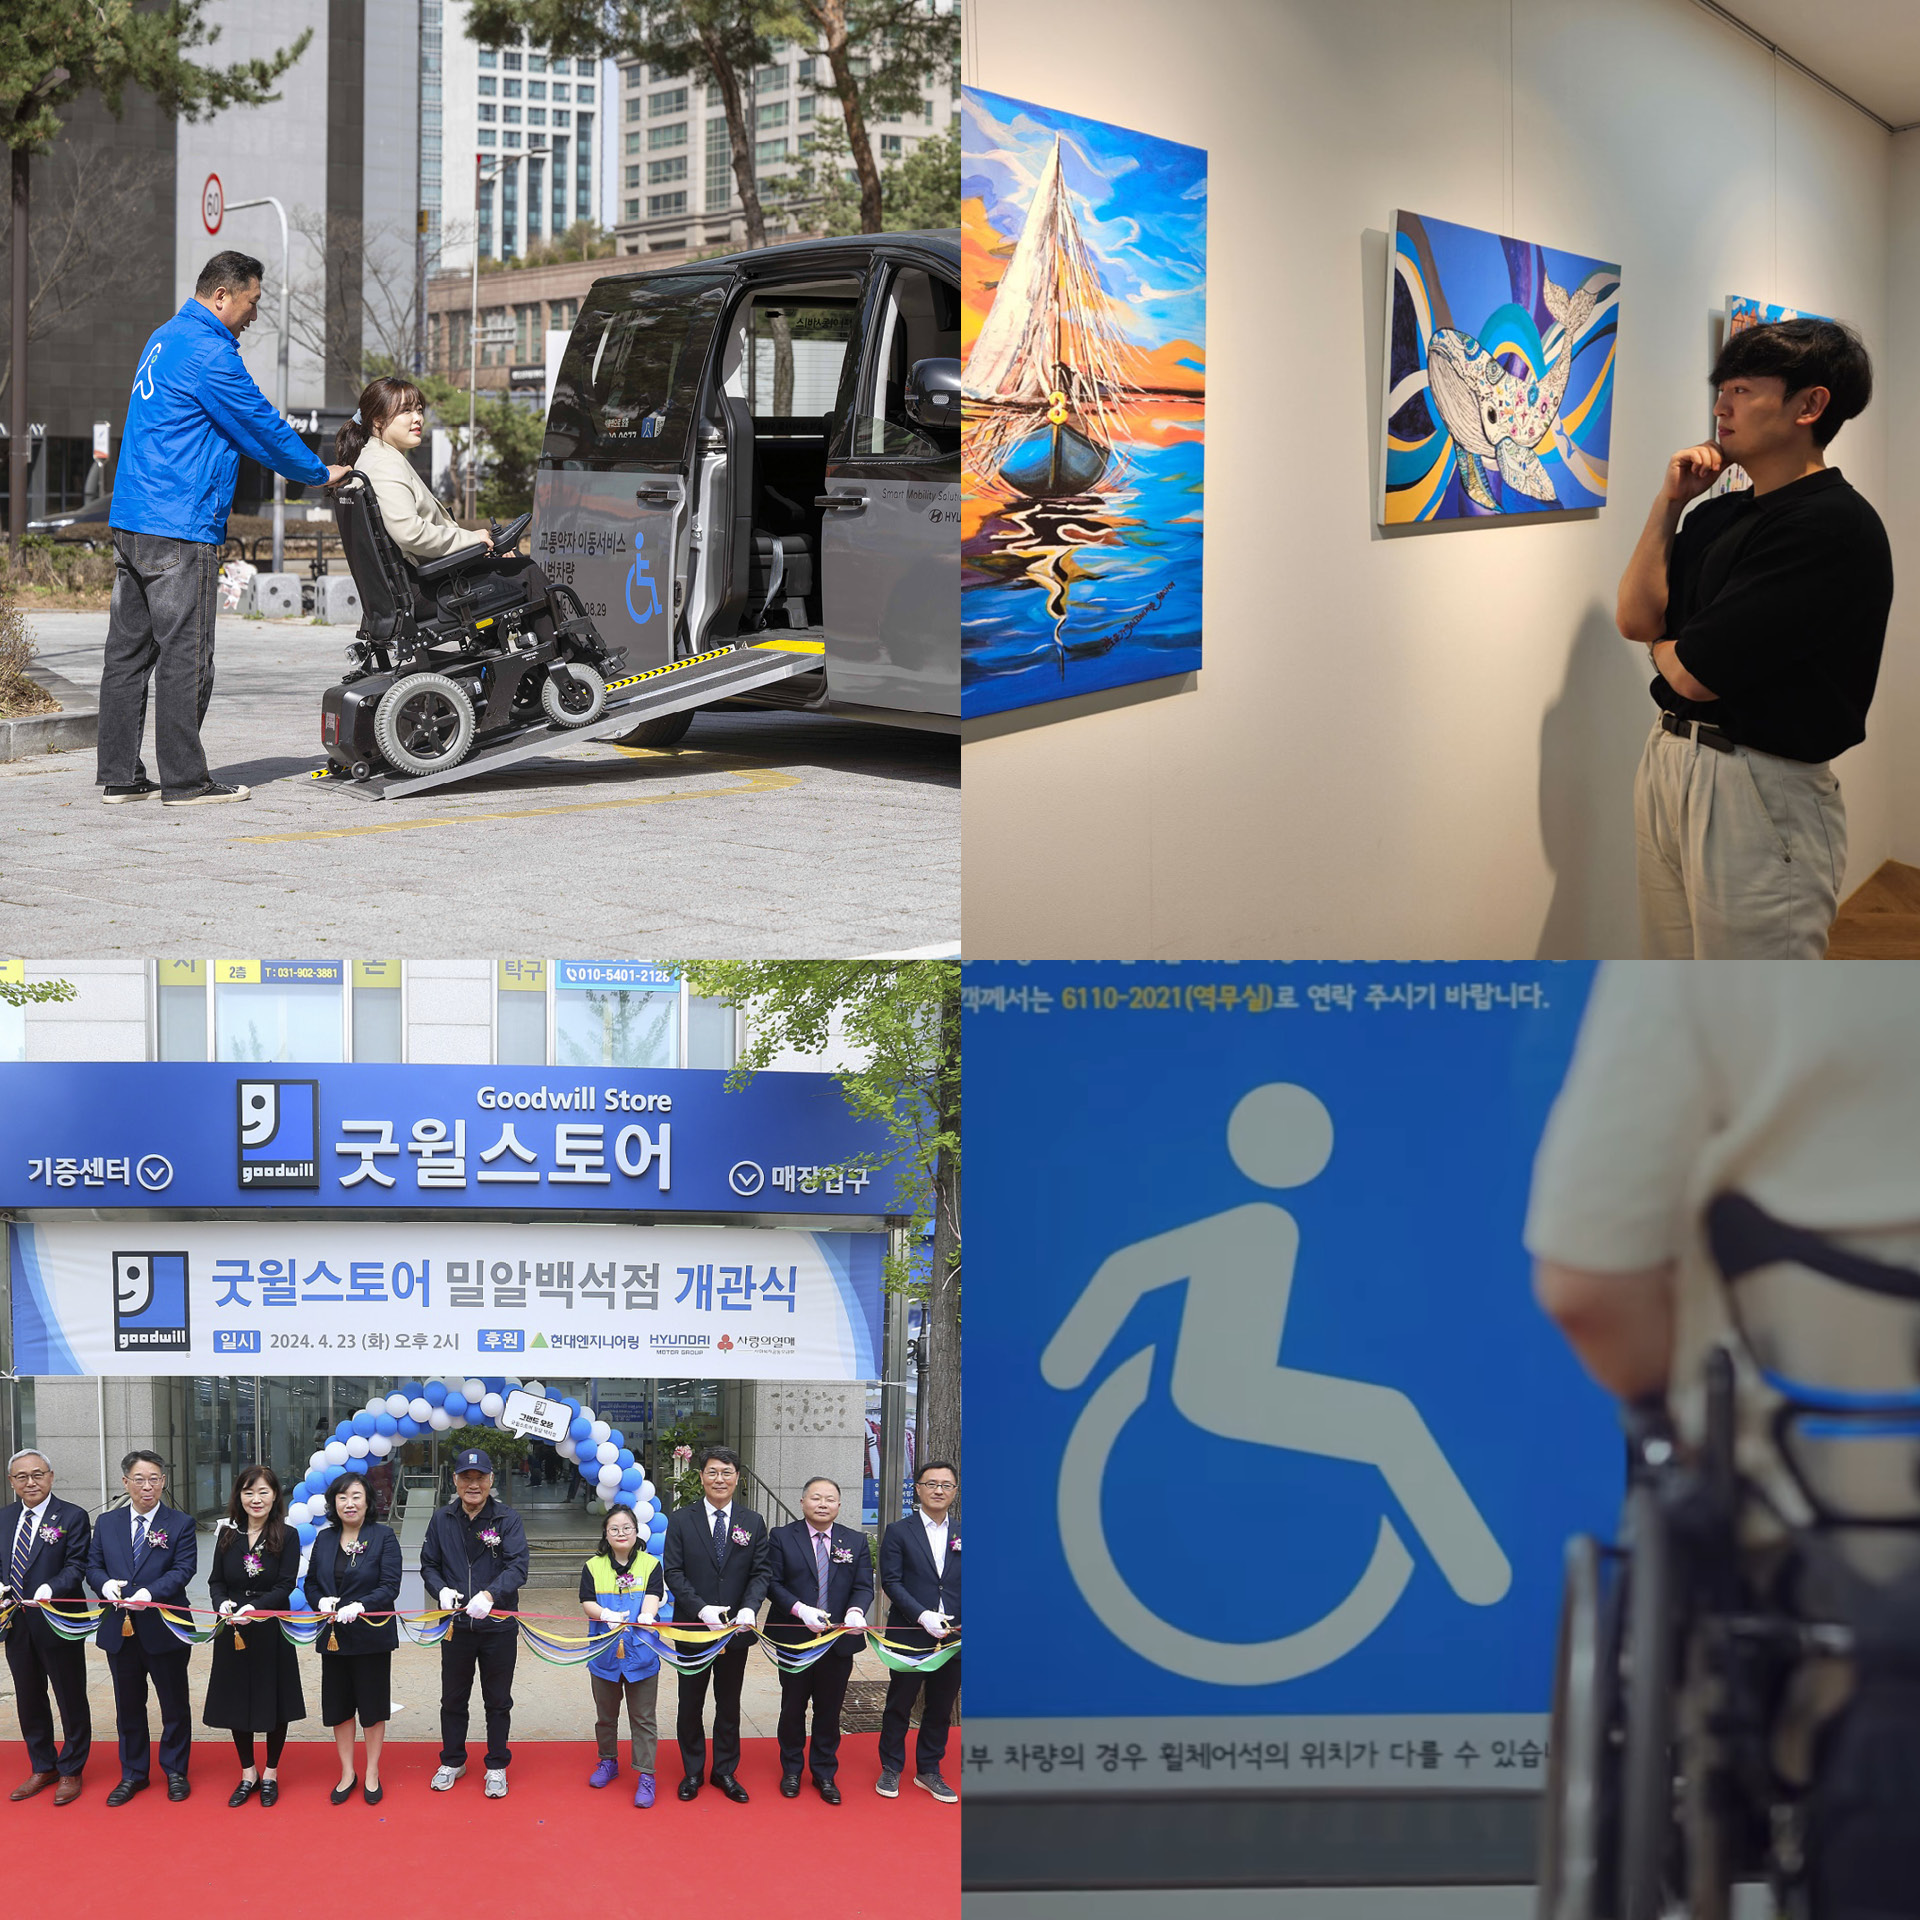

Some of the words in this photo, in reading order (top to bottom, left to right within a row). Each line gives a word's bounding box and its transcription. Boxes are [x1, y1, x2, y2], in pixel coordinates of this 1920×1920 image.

[207, 193, 219, 216] 60
[882, 488, 904, 499] Smart
[907, 489, 936, 502] Mobility
[539, 531, 576, 554] 교통약자
[578, 531, 626, 556] 이동서비스
[229, 966, 247, 979] 2층
[278, 967, 338, 979] 031-902-3881
[504, 960, 543, 981] 탁구
[1061, 983, 1300, 1013] 6110-2021(역무실)로
[1307, 983, 1357, 1012] 연락
[1364, 983, 1436, 1011] 주시기
[1445, 982, 1551, 1011] 바랍니다.
[476, 1086, 596, 1111] Goodwill
[604, 1088, 673, 1112] Store
[335, 1117, 672, 1192] 굿윌스토어
[28, 1157, 131, 1187] 기증센터
[243, 1163, 314, 1183] goodwill
[771, 1165, 871, 1195] 매장입구
[212, 1258, 430, 1308] 굿윌스토어
[446, 1260, 660, 1310] 밀알백석점
[674, 1264, 798, 1313] 개관식
[119, 1330, 186, 1348] goodwill
[220, 1332, 255, 1350] 일시
[270, 1333, 314, 1348] 2024.
[318, 1334, 332, 1348] 4.
[337, 1334, 356, 1348] 23
[361, 1332, 389, 1351] (화)
[394, 1333, 429, 1349] 오후
[433, 1333, 459, 1350] 2시
[484, 1332, 518, 1349] 후원
[550, 1334, 640, 1350] 현대엔지니어링
[650, 1334, 711, 1346] HYUNDAI
[736, 1336, 795, 1349] 사랑의열매
[961, 1743, 993, 1773] 부
[1004, 1743, 1085, 1773] 차량의
[1096, 1742, 1148, 1773] 경우
[1159, 1741, 1290, 1773] 휠체어석의
[1300, 1740, 1380, 1770] 위치가
[1389, 1740, 1443, 1770] 다를
[1453, 1740, 1481, 1769] 수
[1490, 1739, 1550, 1769] 있습
